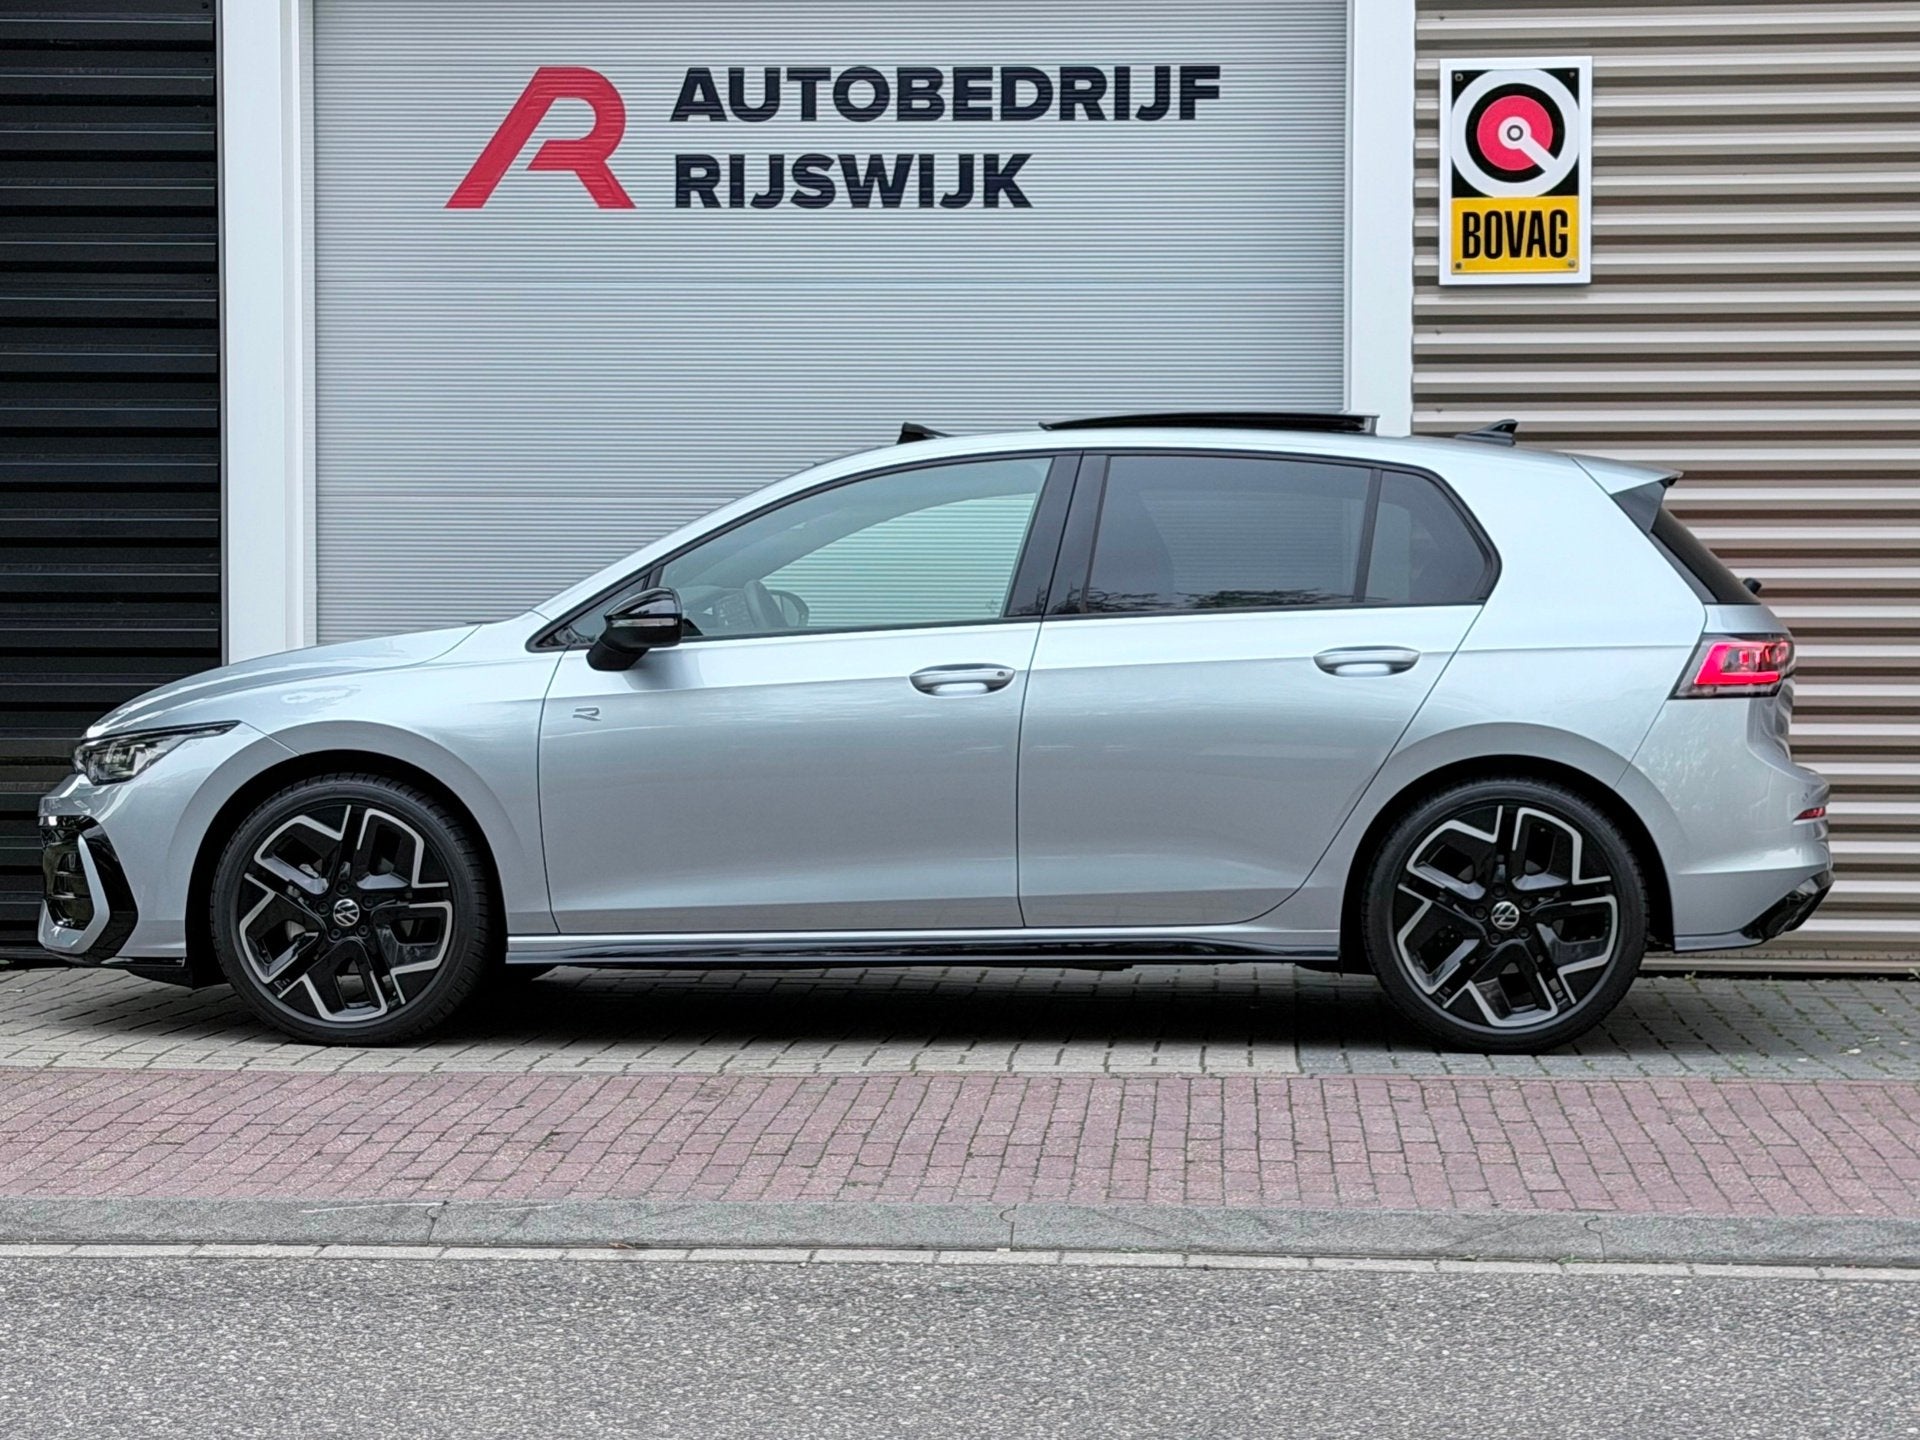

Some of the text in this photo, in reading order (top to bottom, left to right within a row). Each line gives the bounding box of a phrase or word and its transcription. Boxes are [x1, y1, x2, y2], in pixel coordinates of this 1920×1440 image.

[670, 65, 1221, 122] AUTOBEDRIJF
[675, 153, 1033, 209] RIJSWIJK
[1461, 208, 1568, 260] BOVAG
